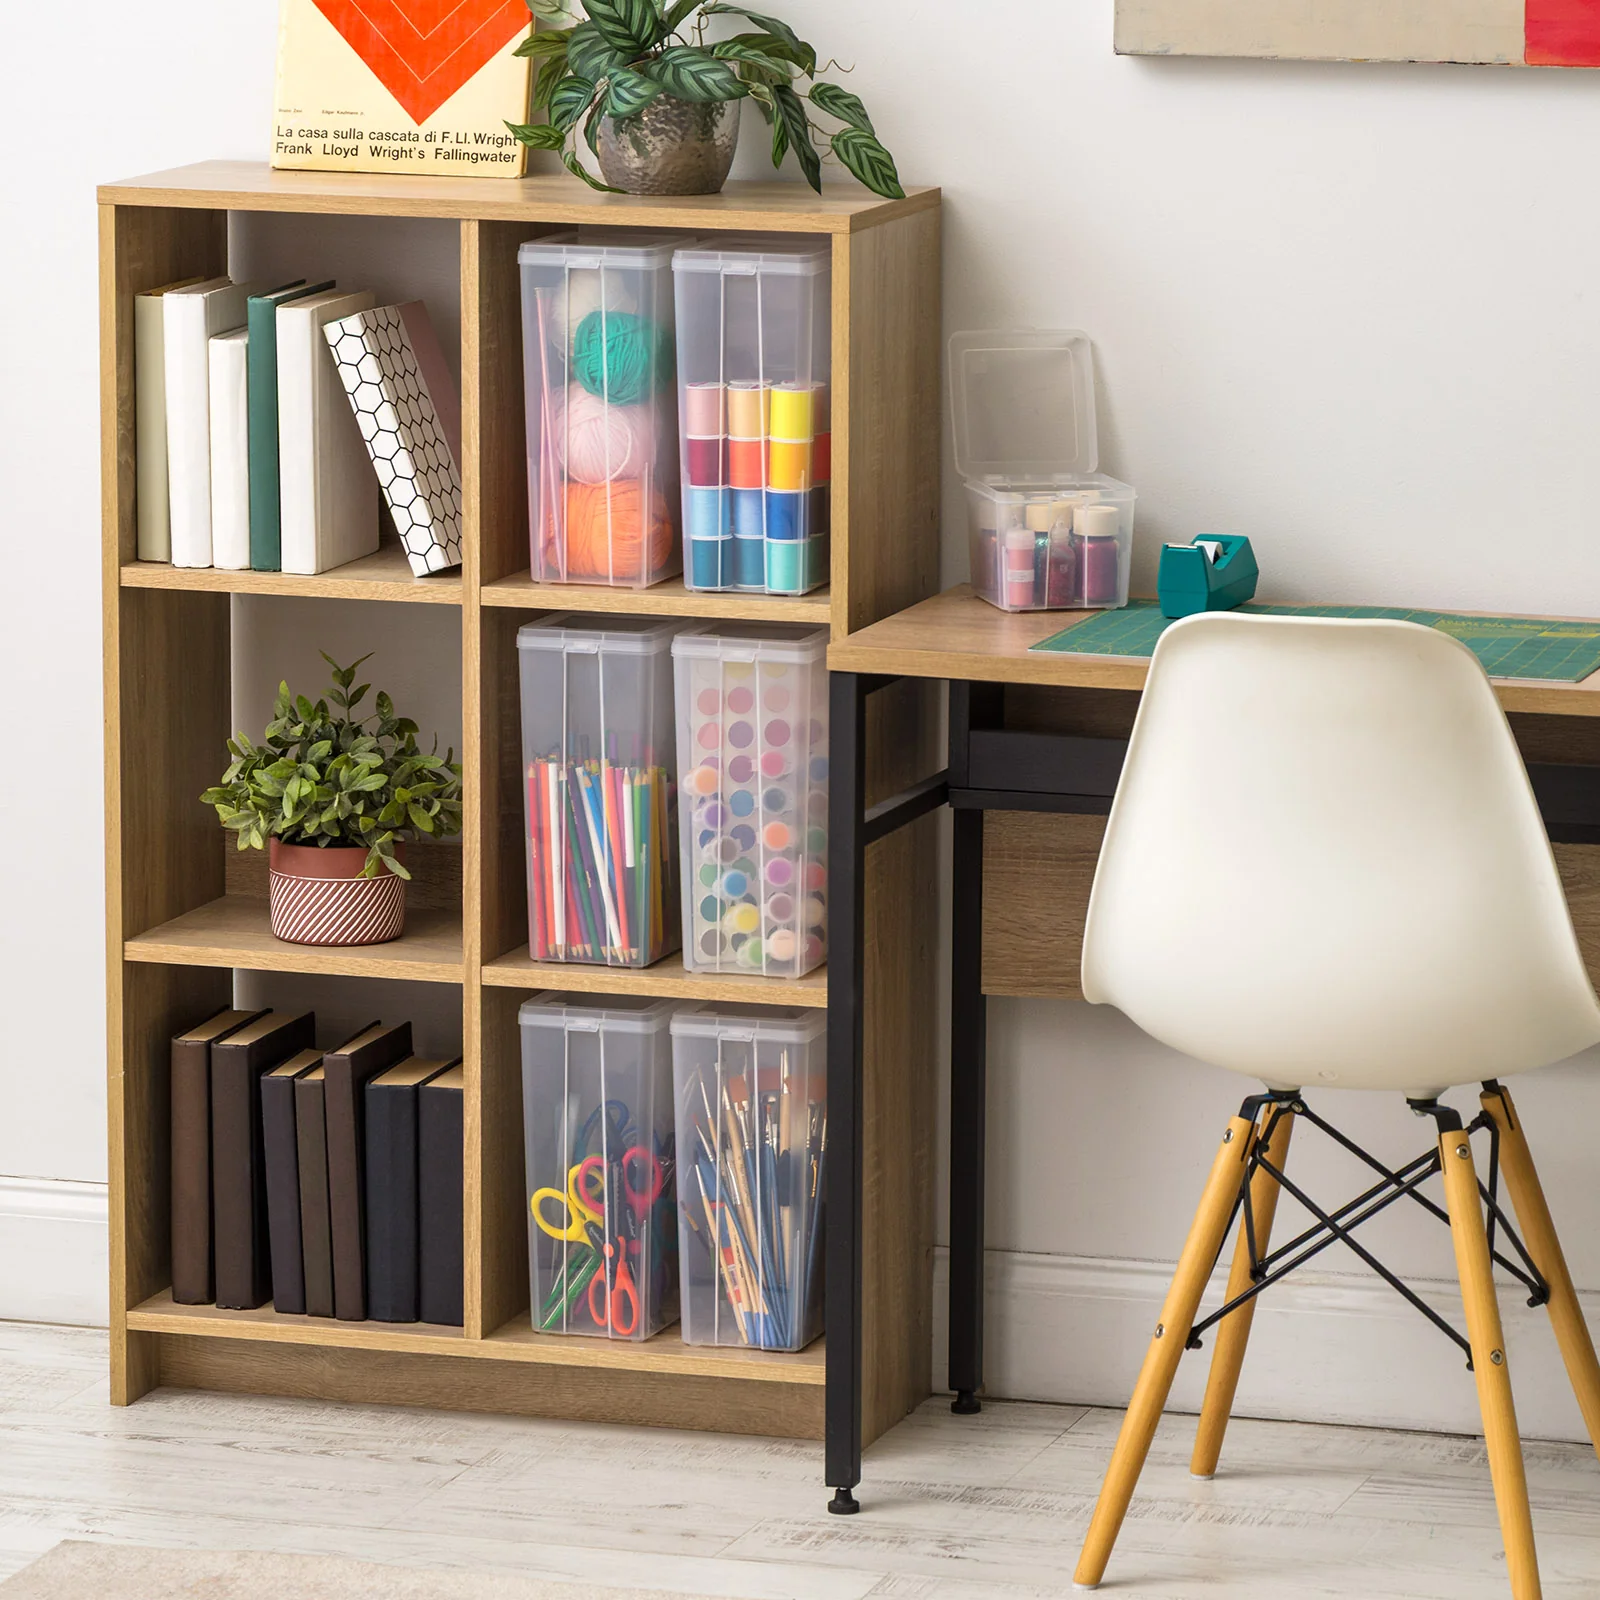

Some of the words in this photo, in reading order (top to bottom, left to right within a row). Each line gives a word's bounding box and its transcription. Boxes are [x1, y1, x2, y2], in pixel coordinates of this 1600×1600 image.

[277, 125, 293, 137] La
[298, 128, 328, 138] casa
[333, 128, 364, 139] sulla
[368, 130, 419, 142] cascata
[424, 131, 437, 142] di
[473, 132, 517, 148] Wright
[276, 142, 313, 154] Frank
[322, 143, 359, 158] Lloyd
[369, 145, 425, 160] Wright's
[434, 147, 517, 164] Fallingwater
